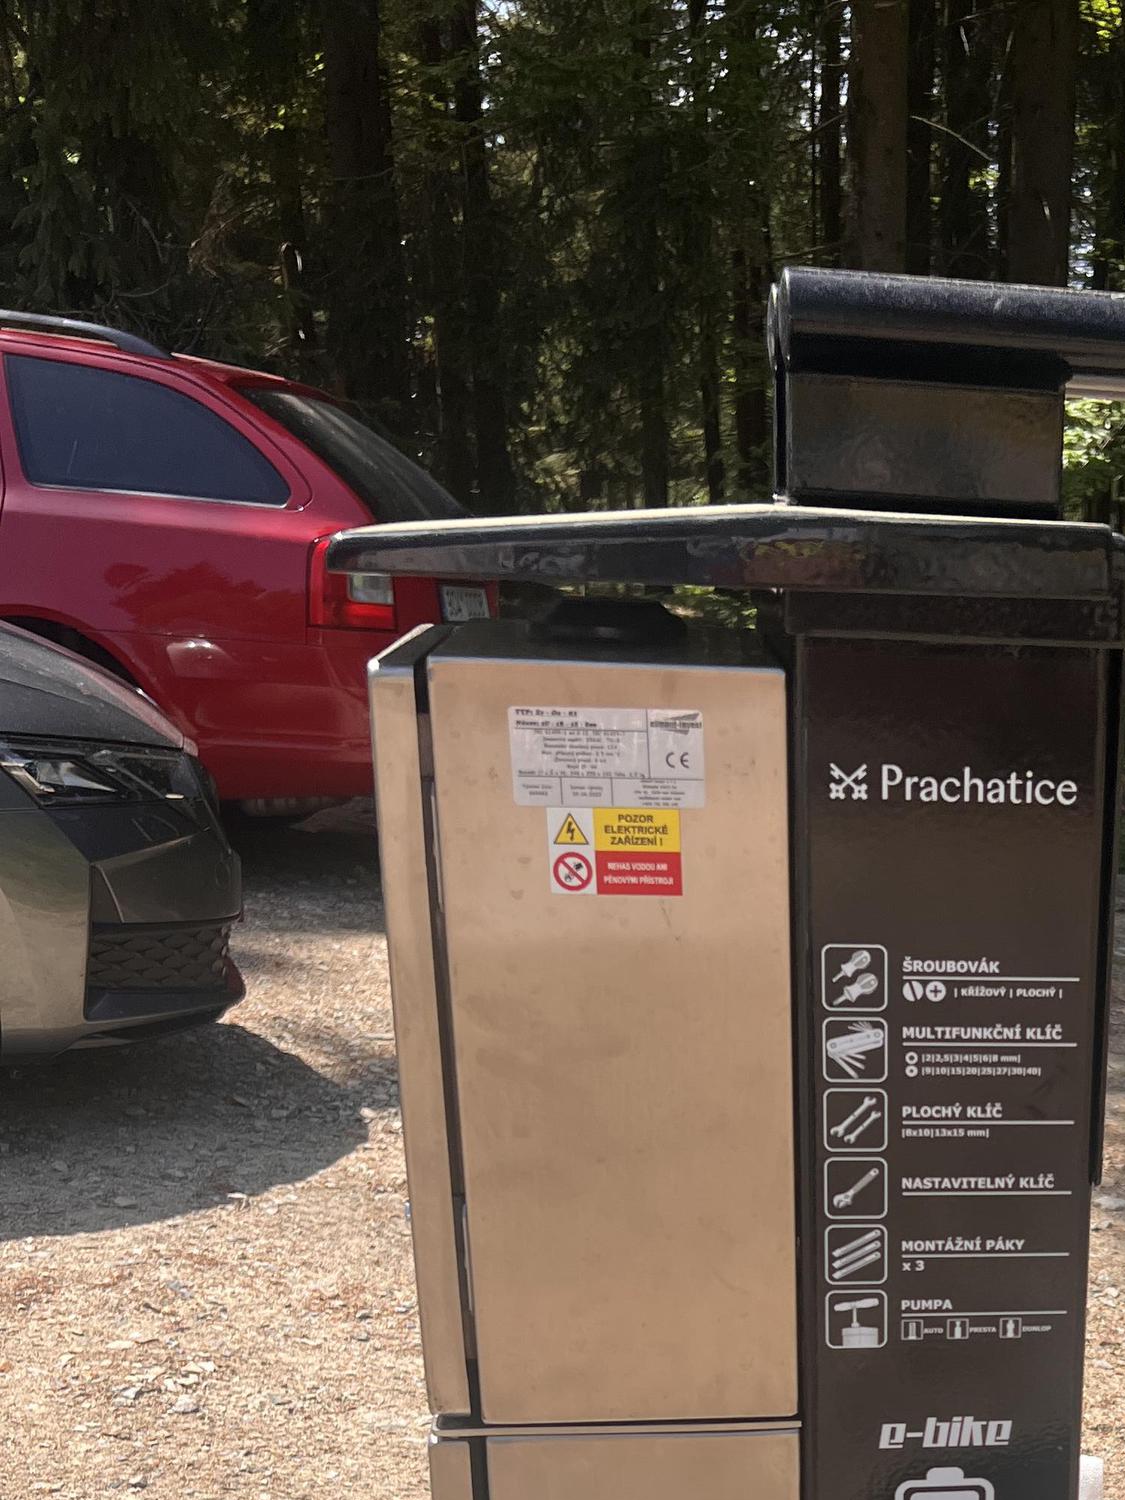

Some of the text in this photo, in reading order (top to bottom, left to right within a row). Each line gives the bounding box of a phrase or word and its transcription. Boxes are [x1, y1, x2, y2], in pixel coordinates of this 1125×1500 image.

[881, 764, 1078, 806] Prachatice
[617, 813, 654, 824] POZOR
[604, 823, 669, 836] ELEKTRICKÉ
[610, 835, 658, 847] ZAŘÍZENÍ
[902, 956, 1000, 974] ŠROUBOVÁK
[960, 985, 1056, 999] KŘÍŽOVÝ PLOCHÝ
[902, 1023, 1063, 1041] MULTIFUNKČNÍ KLÍČ
[902, 1100, 1002, 1118] PLOCHÝ KLÍČ
[901, 1172, 1055, 1190] NASTAVITELNÝ KLÍČ
[901, 1235, 1026, 1253] MONTÁŽNÍ PÁKY
[915, 1259, 924, 1271] 3
[901, 1298, 953, 1311] PUMPA
[923, 1327, 944, 1335] AUTO
[969, 1325, 997, 1334] PRESTA
[878, 1414, 1013, 1449] e-bike
